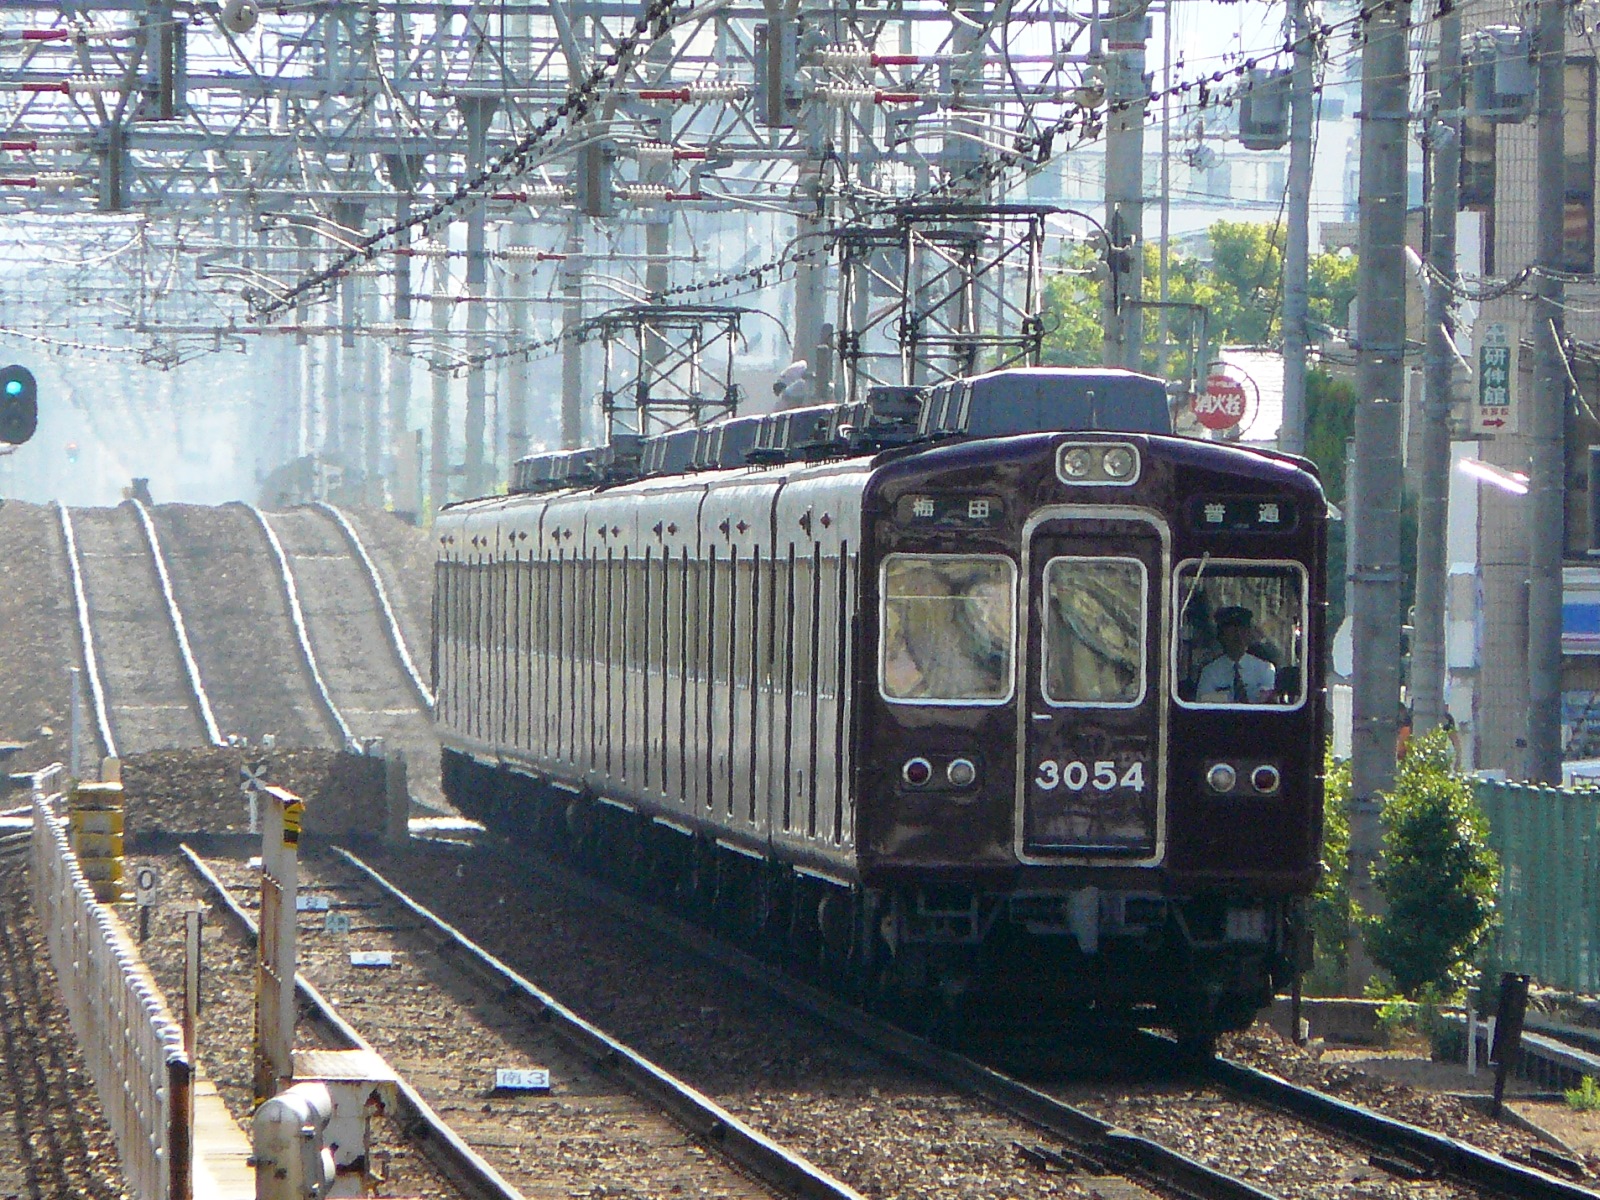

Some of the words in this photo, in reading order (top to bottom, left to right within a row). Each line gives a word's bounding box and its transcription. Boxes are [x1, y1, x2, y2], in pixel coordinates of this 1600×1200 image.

[1195, 393, 1243, 416] 消火栓
[1035, 760, 1145, 792] 3054
